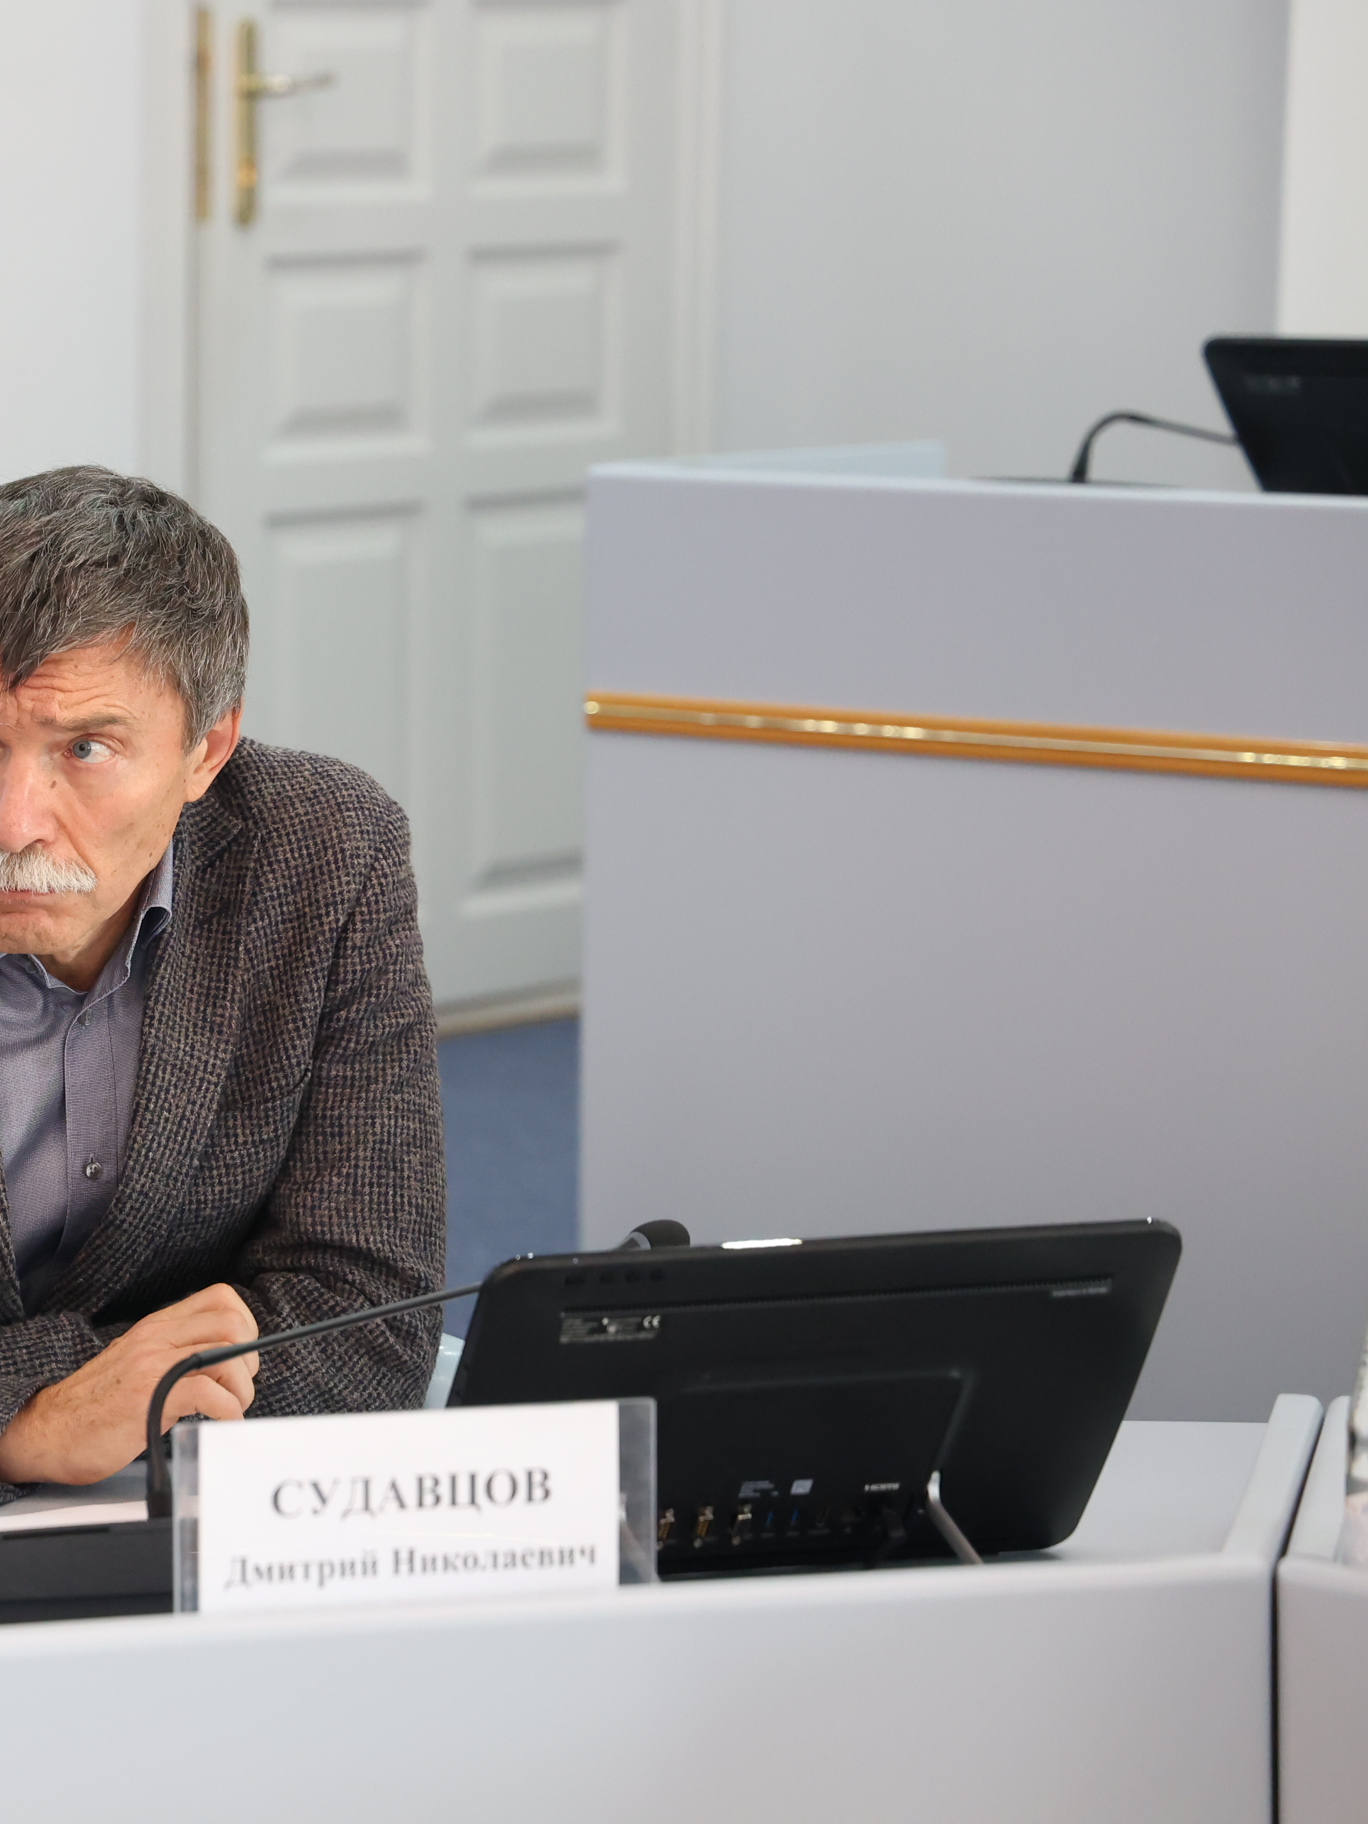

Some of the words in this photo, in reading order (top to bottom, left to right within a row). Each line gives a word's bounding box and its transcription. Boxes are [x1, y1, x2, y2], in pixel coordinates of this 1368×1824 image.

[271, 1467, 552, 1521] СУДАВЦОВ
[223, 1551, 379, 1590] Дмитрий
[392, 1544, 597, 1578] Николаевич
